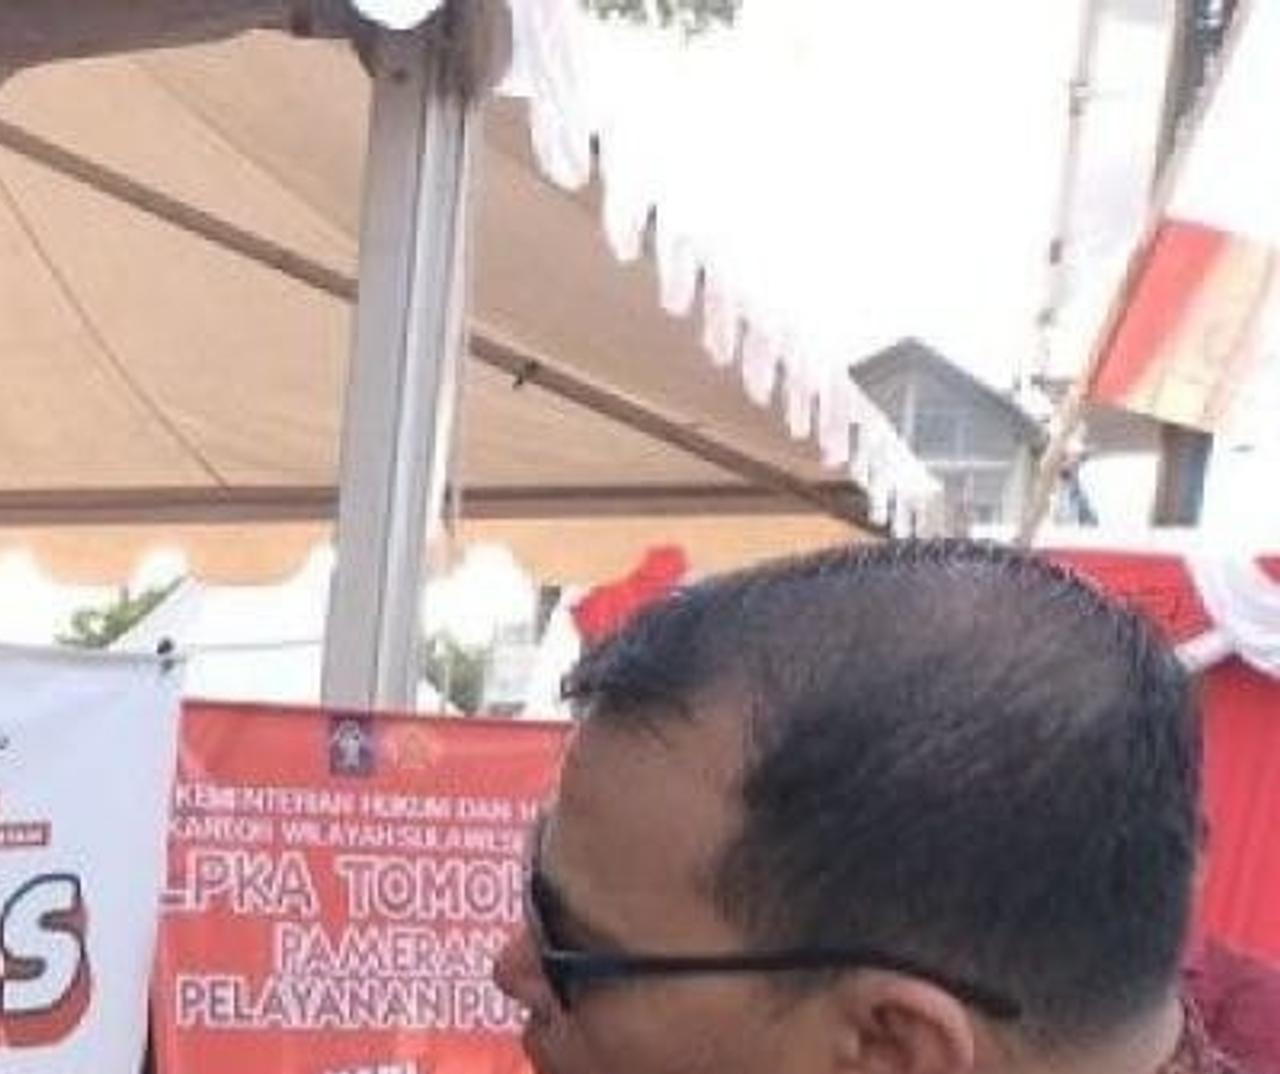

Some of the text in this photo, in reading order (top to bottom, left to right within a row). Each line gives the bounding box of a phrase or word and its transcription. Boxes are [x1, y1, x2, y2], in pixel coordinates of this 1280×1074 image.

[175, 784, 353, 816] KEMENTERIAN
[361, 793, 451, 819] HUKUM
[458, 797, 513, 821] DAN
[281, 820, 395, 849] WILAYAH
[177, 973, 452, 1030] PELAYANAN
